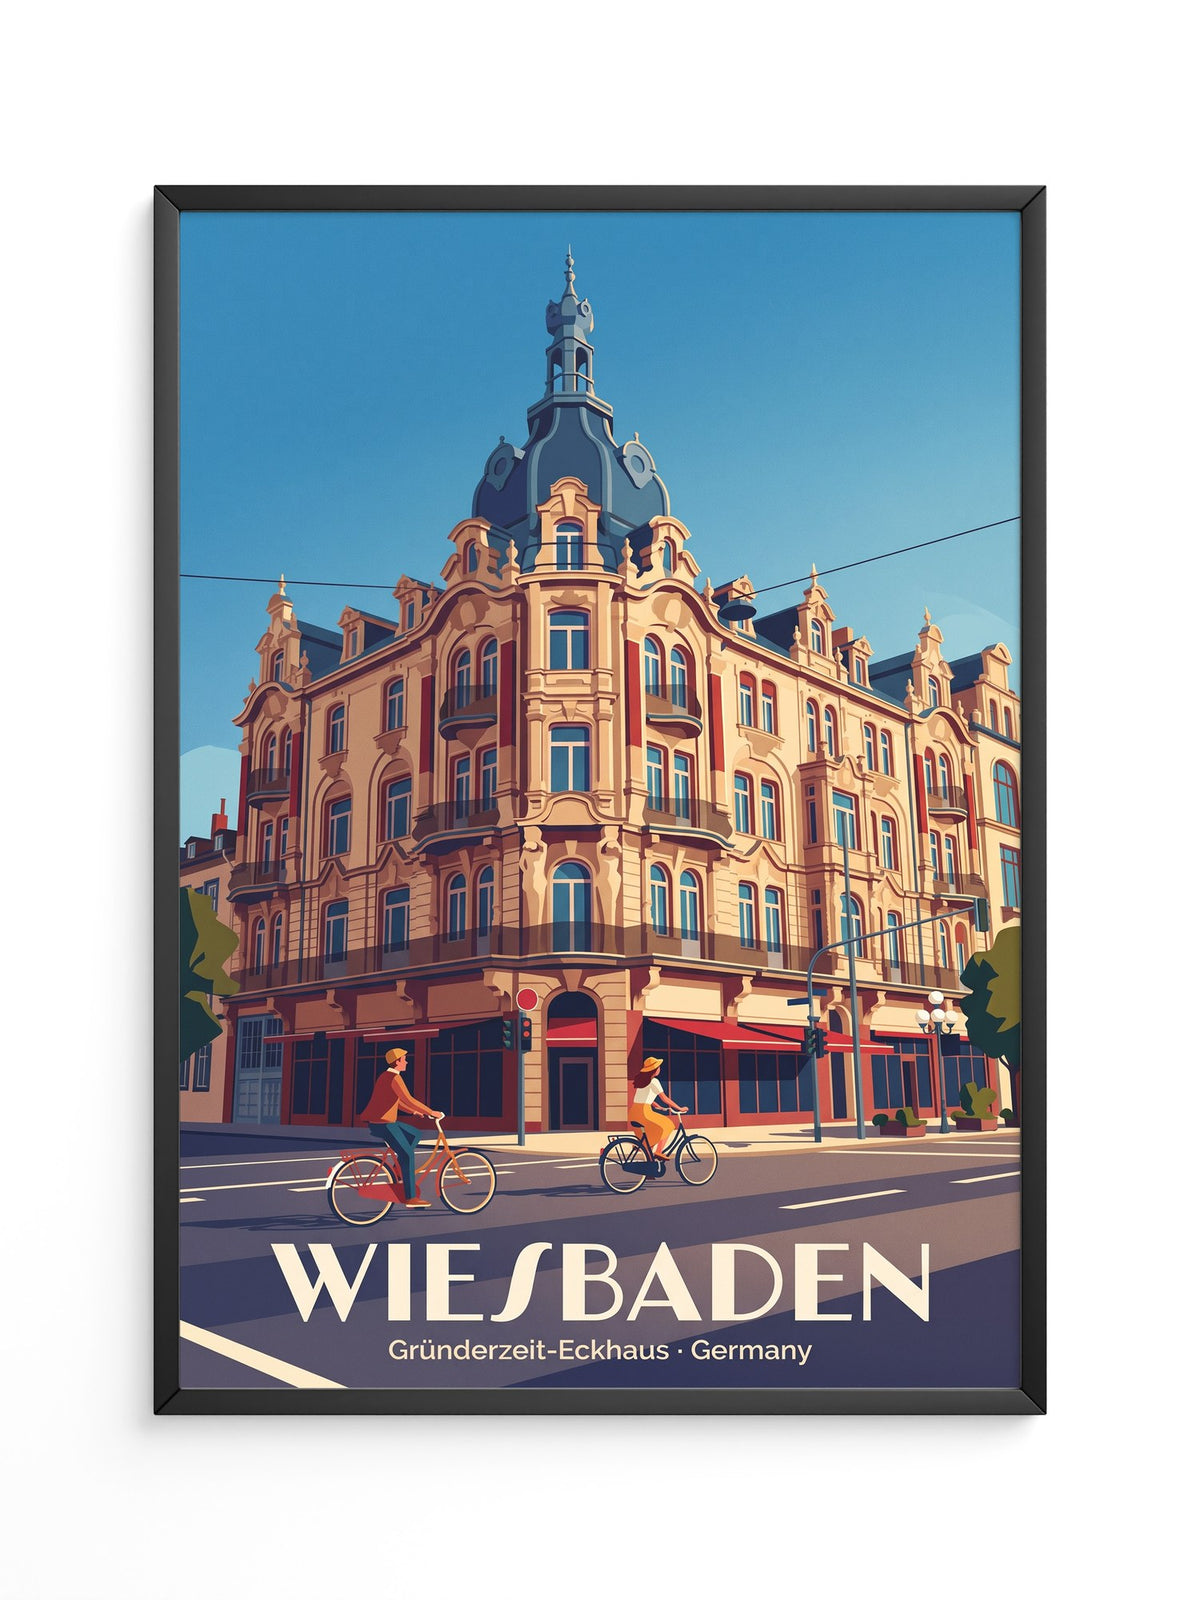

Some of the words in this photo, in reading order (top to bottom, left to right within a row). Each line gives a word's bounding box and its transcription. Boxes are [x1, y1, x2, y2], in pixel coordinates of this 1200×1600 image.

[270, 1241, 930, 1323] WIESBADEN
[388, 1338, 670, 1361] Gründerzeit-Eckhaus
[691, 1338, 813, 1366] Germany
